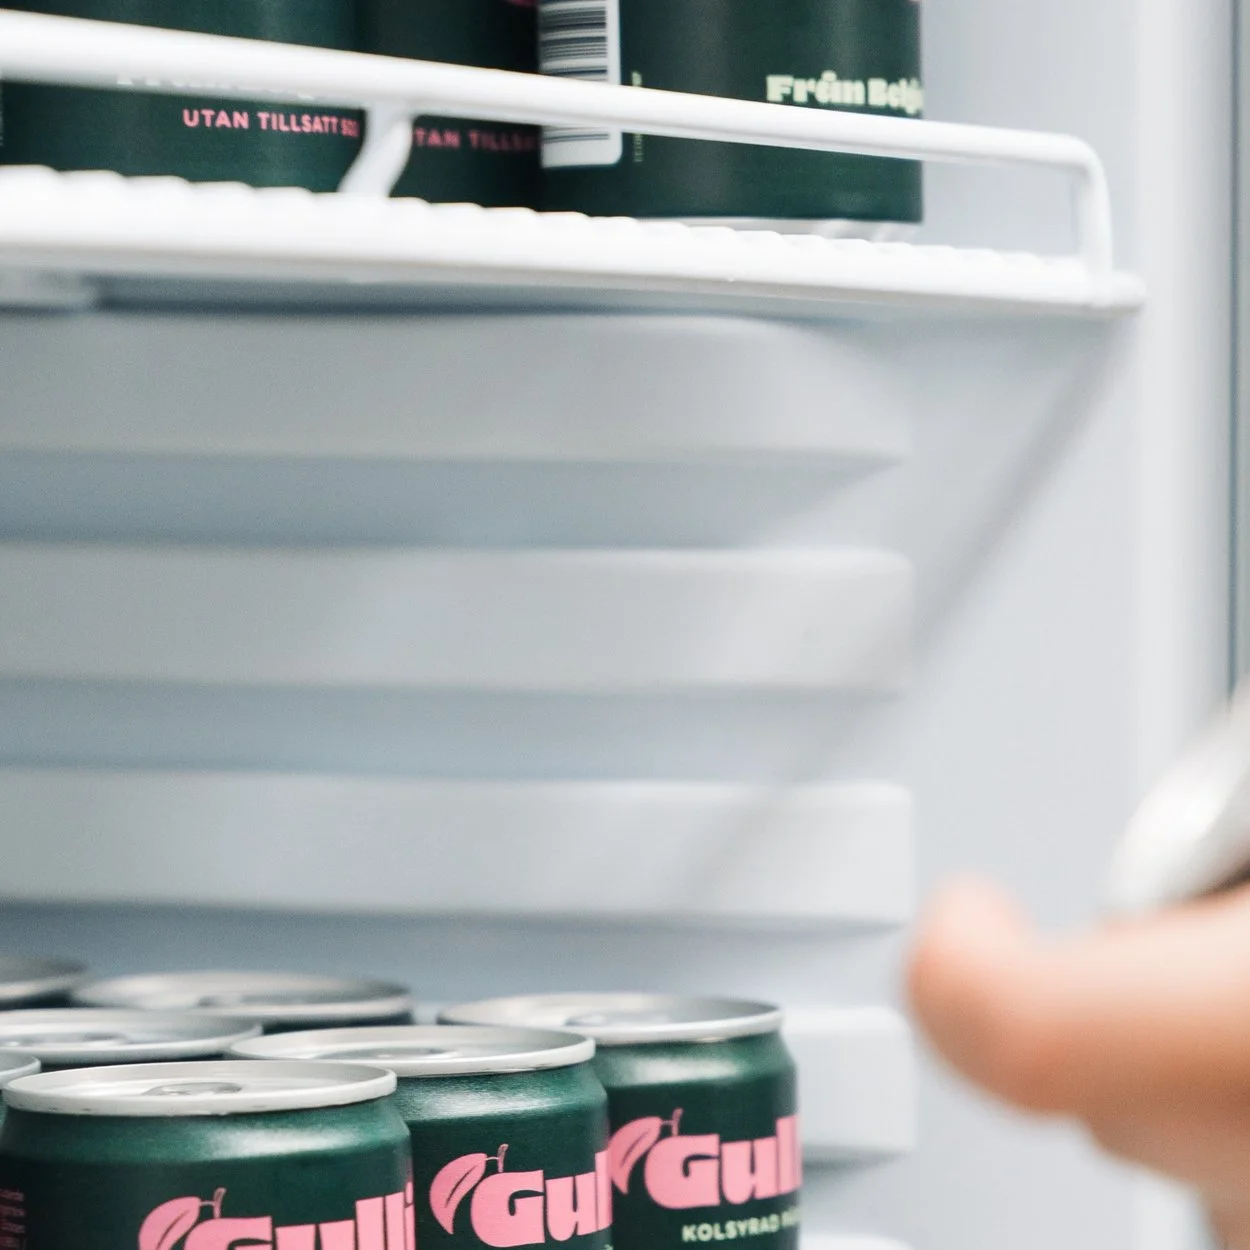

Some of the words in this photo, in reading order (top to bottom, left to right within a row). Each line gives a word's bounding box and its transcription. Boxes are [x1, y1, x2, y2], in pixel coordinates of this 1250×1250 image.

[766, 70, 865, 104] Från
[182, 108, 249, 130] UTAN
[257, 111, 338, 135] TILLSATT
[412, 128, 460, 149] TAN
[681, 1213, 779, 1243] KOLSYRAD
